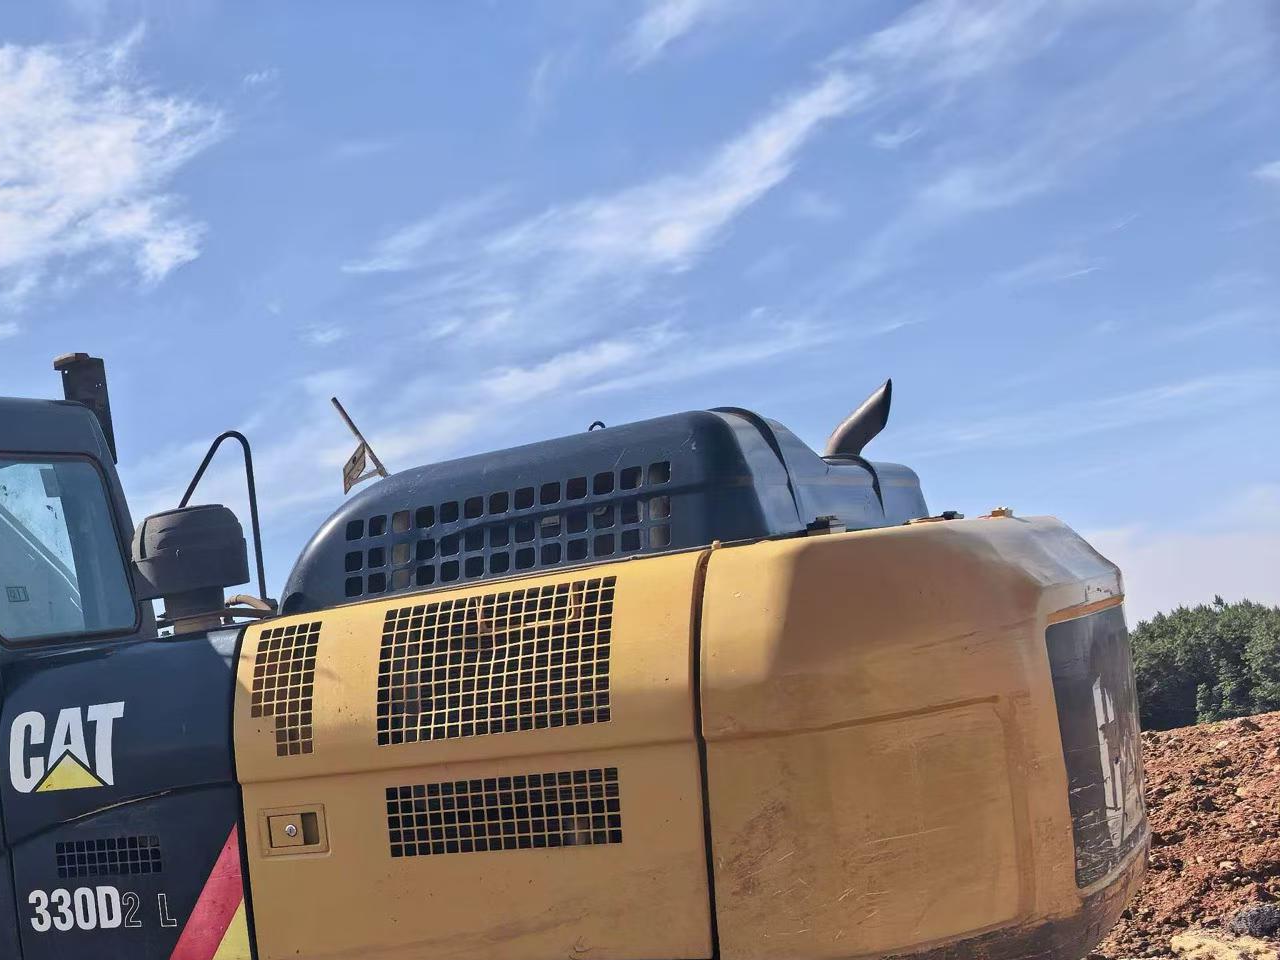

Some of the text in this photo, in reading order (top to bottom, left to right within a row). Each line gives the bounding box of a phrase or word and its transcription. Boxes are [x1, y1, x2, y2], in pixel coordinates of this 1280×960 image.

[9, 701, 125, 793] CAT
[28, 885, 178, 932] 330D2 L
